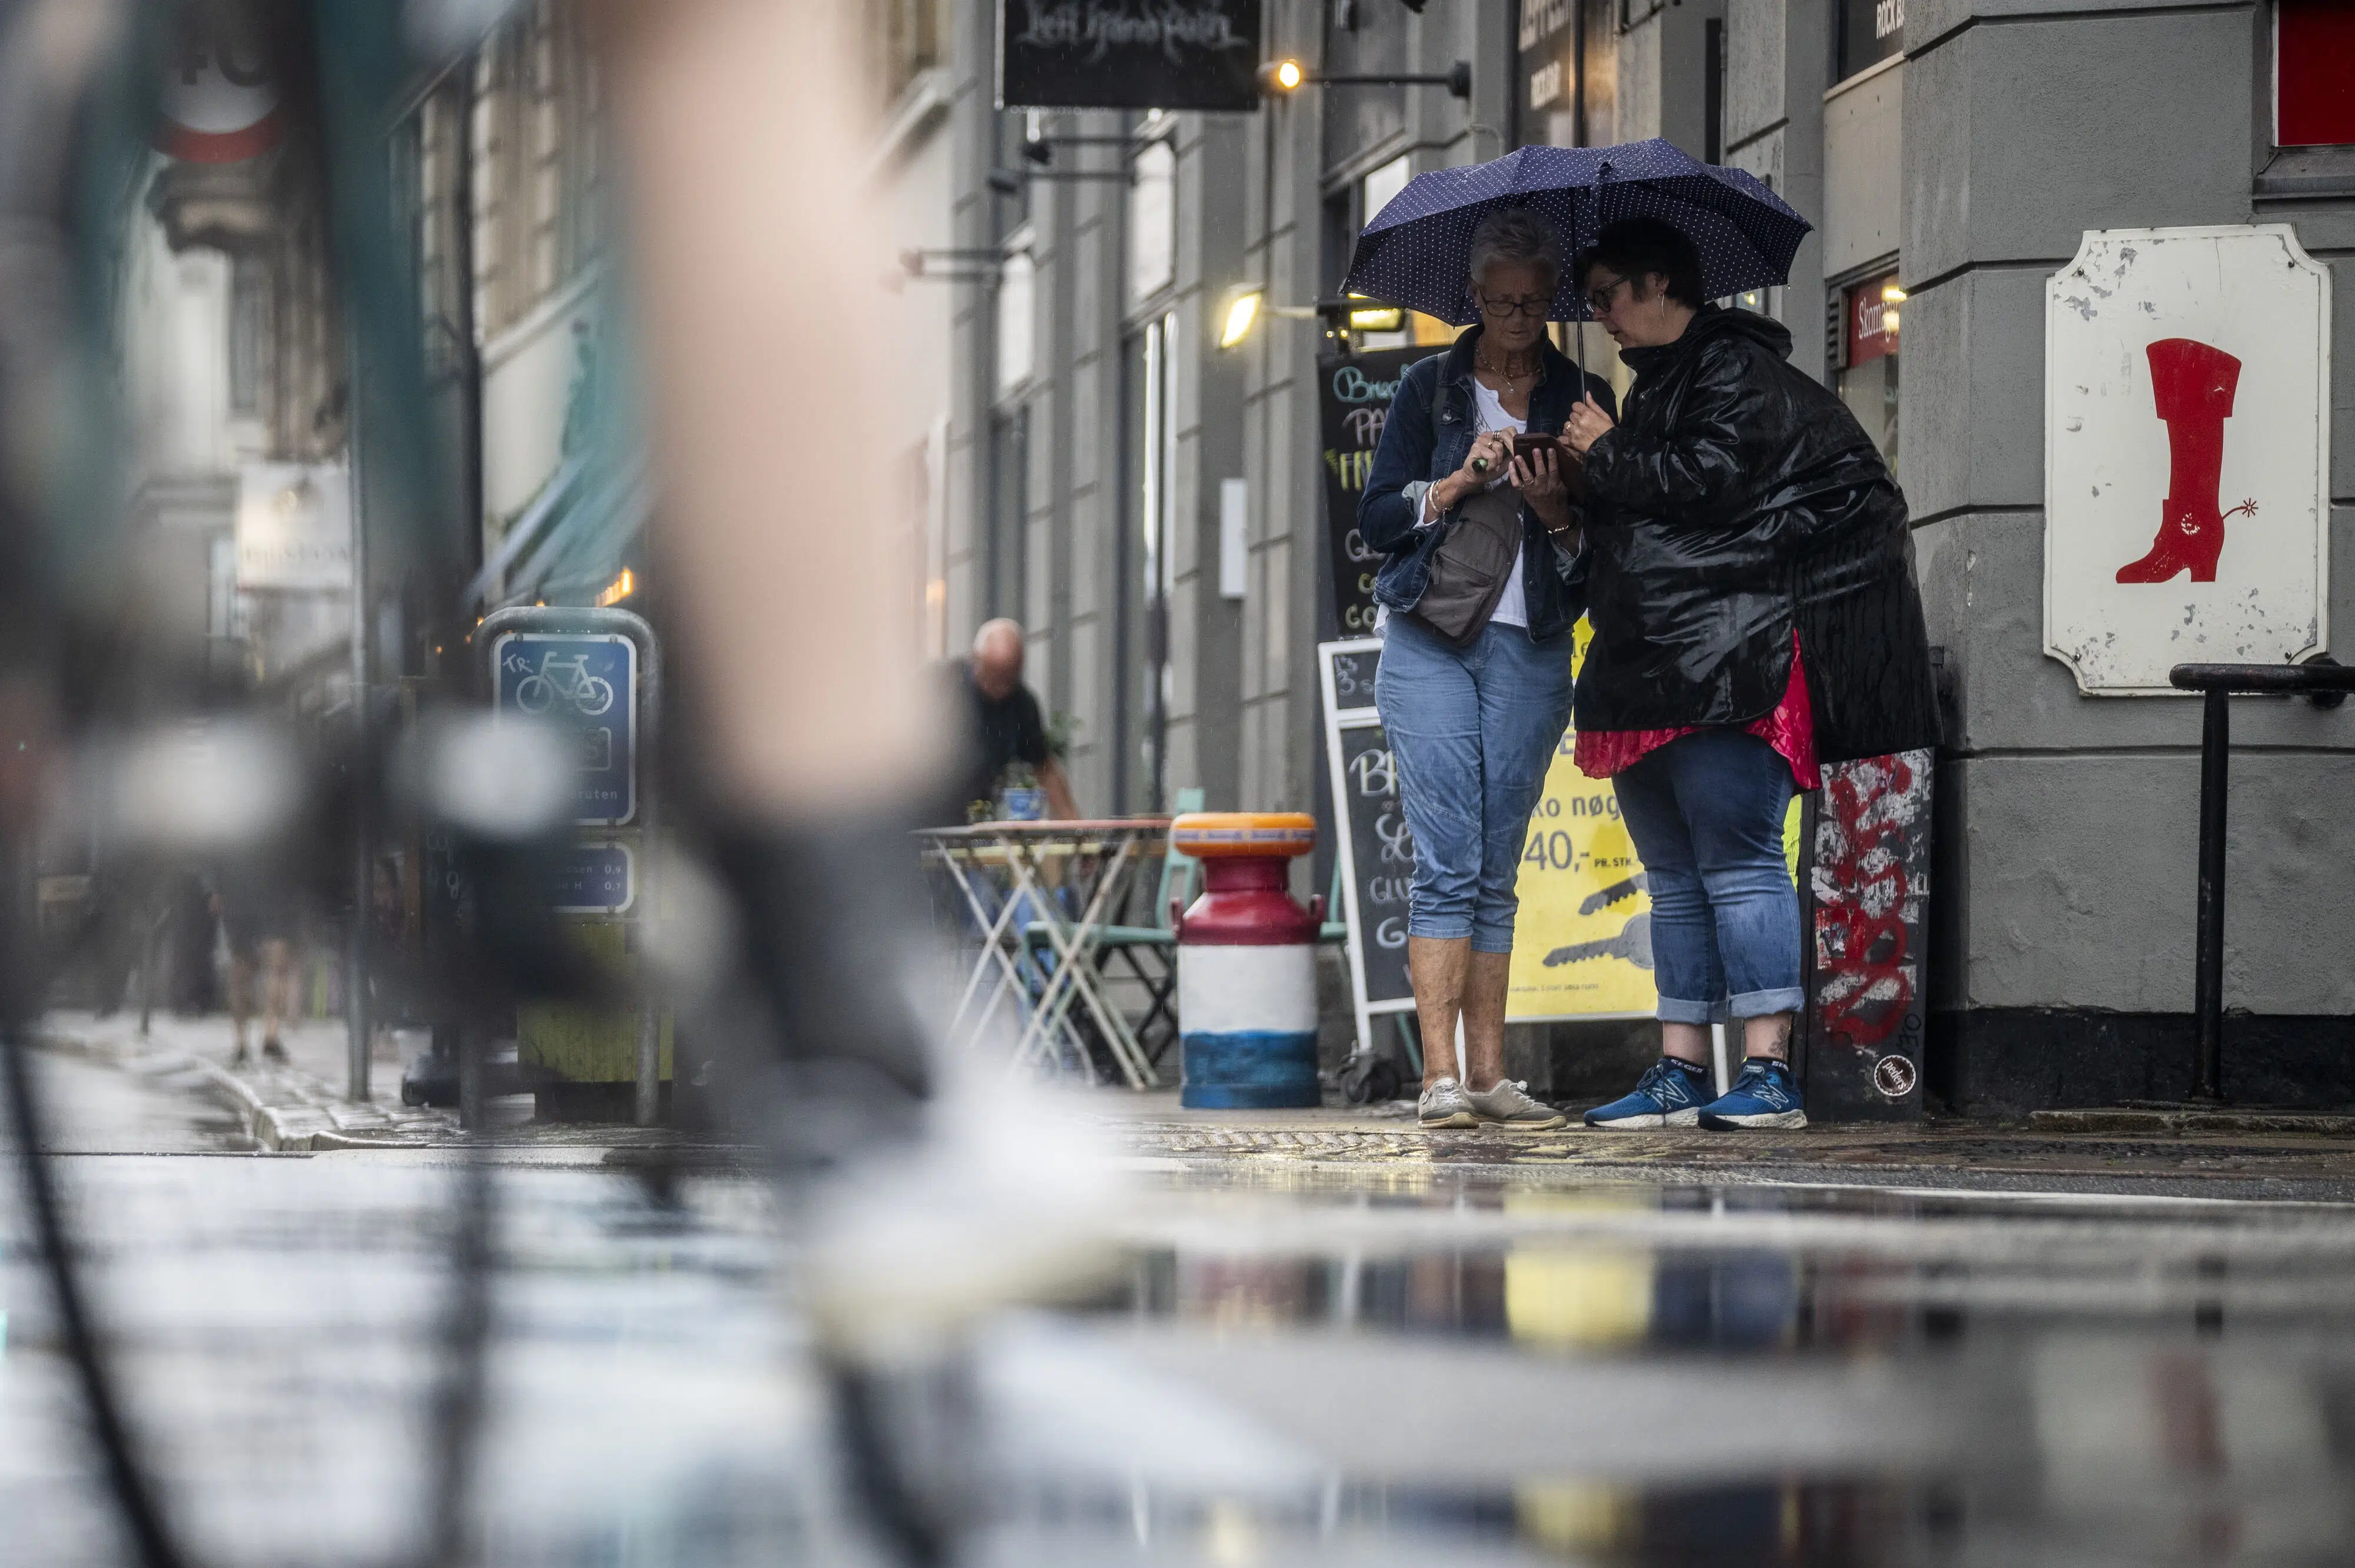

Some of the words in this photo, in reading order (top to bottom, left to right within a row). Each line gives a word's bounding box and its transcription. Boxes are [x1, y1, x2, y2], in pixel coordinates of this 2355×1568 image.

[1876, 0, 1895, 39] ROCK
[1524, 830, 1590, 872] 40,-
[1882, 1061, 1907, 1089] peders
